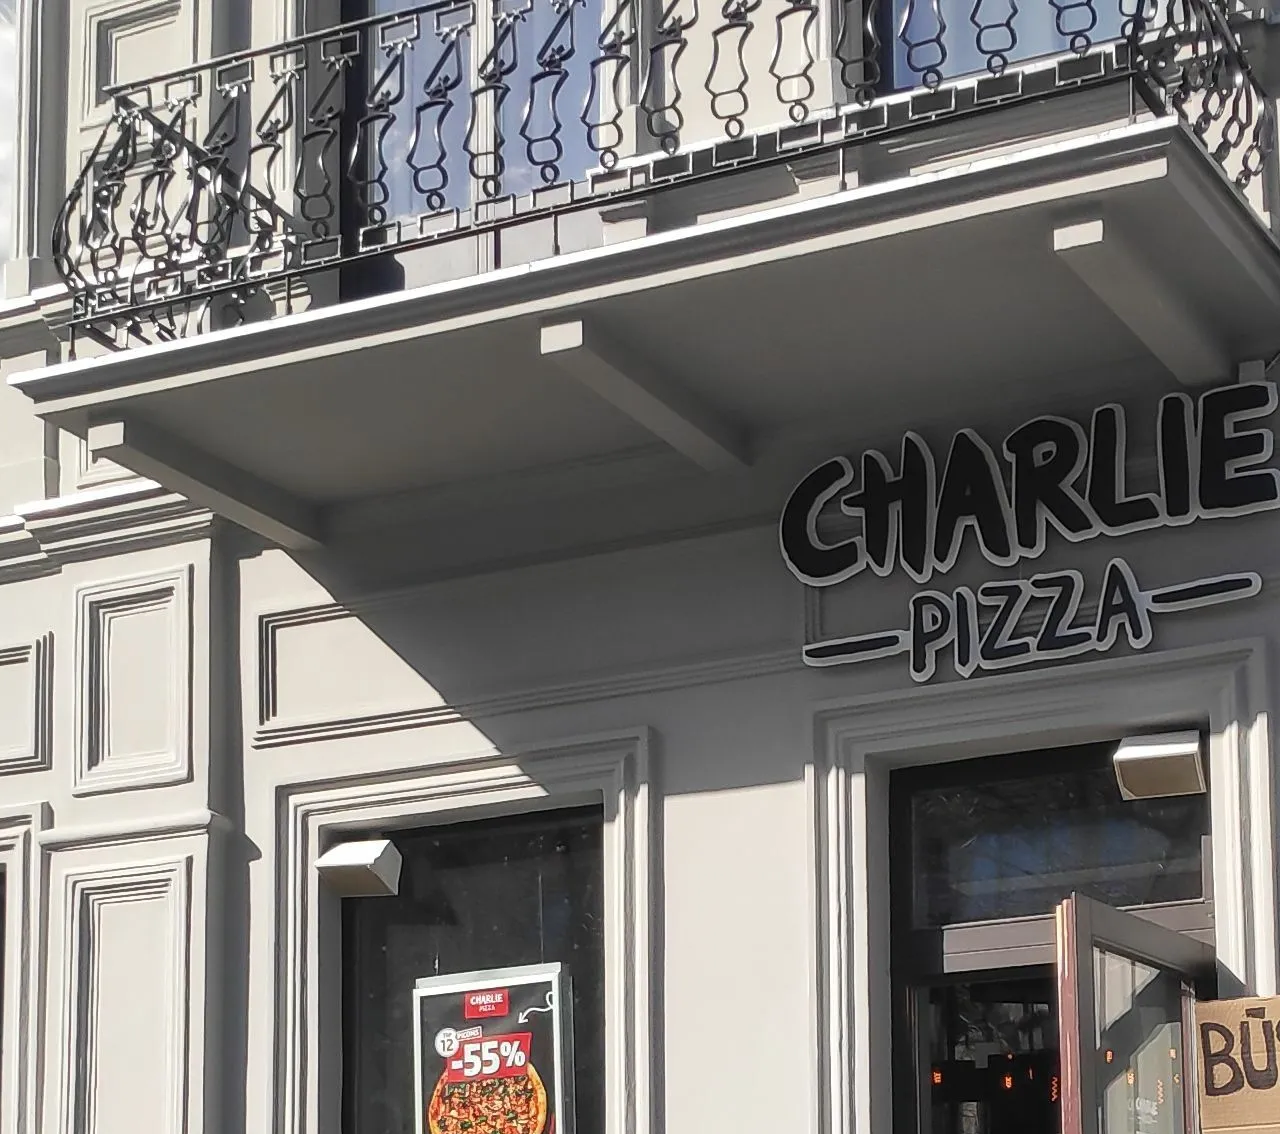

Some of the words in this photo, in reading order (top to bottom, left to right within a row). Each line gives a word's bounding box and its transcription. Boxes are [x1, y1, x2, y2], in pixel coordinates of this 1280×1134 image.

[909, 558, 1153, 683] PIZZA
[441, 1039, 454, 1052] 12
[451, 1040, 526, 1077] -55%
